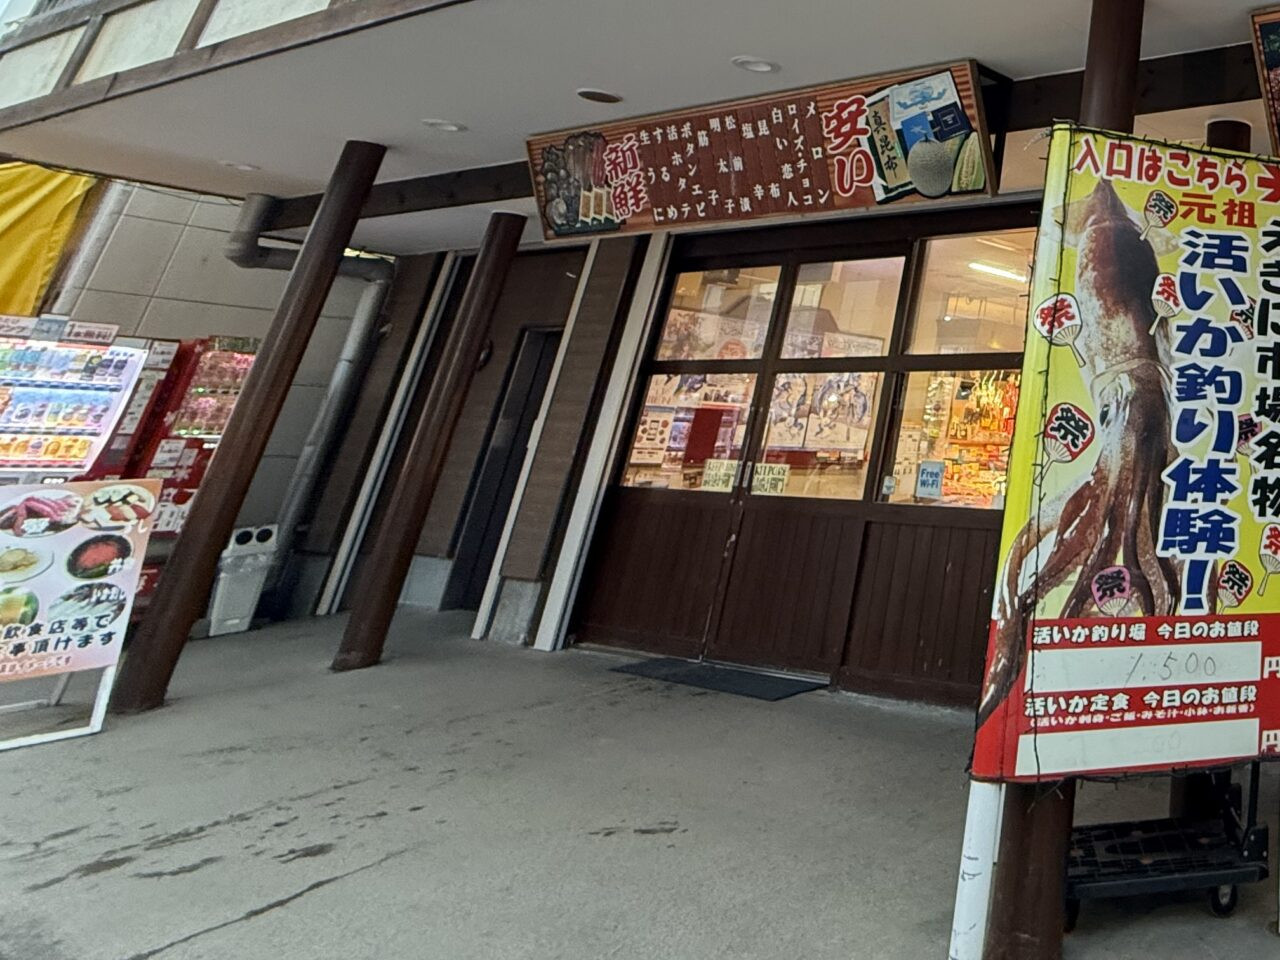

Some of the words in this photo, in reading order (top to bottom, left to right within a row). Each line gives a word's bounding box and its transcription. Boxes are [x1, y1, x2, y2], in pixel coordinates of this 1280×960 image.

[603, 133, 649, 223] 新鮮
[640, 129, 665, 221] 生うに
[653, 127, 678, 220] するめ
[666, 124, 691, 218] 活ホタテ
[681, 121, 706, 217] ボタンエビ
[697, 130, 719, 206] 筋子
[709, 117, 735, 214] 明太子
[724, 115, 752, 213] 松前漬
[741, 123, 765, 200] 塩辛
[757, 119, 781, 199] 昆布
[771, 107, 799, 208] 白い恋人
[805, 101, 830, 205] メロン
[822, 95, 875, 196] 安い
[1074, 137, 1249, 196] 入口はこちら
[1179, 191, 1257, 228] 元祖
[1160, 231, 1250, 609] 活いか釣り体験！
[920, 468, 940, 478] Free
[920, 479, 939, 489] Wi-Fi
[0, 631, 117, 657] 事頂けます
[1033, 624, 1147, 645] 活いか釣り堀
[1157, 620, 1260, 640] 今日のお値段
[1024, 692, 1131, 717] 活いか定食
[1143, 685, 1258, 708] 今日のお値段
